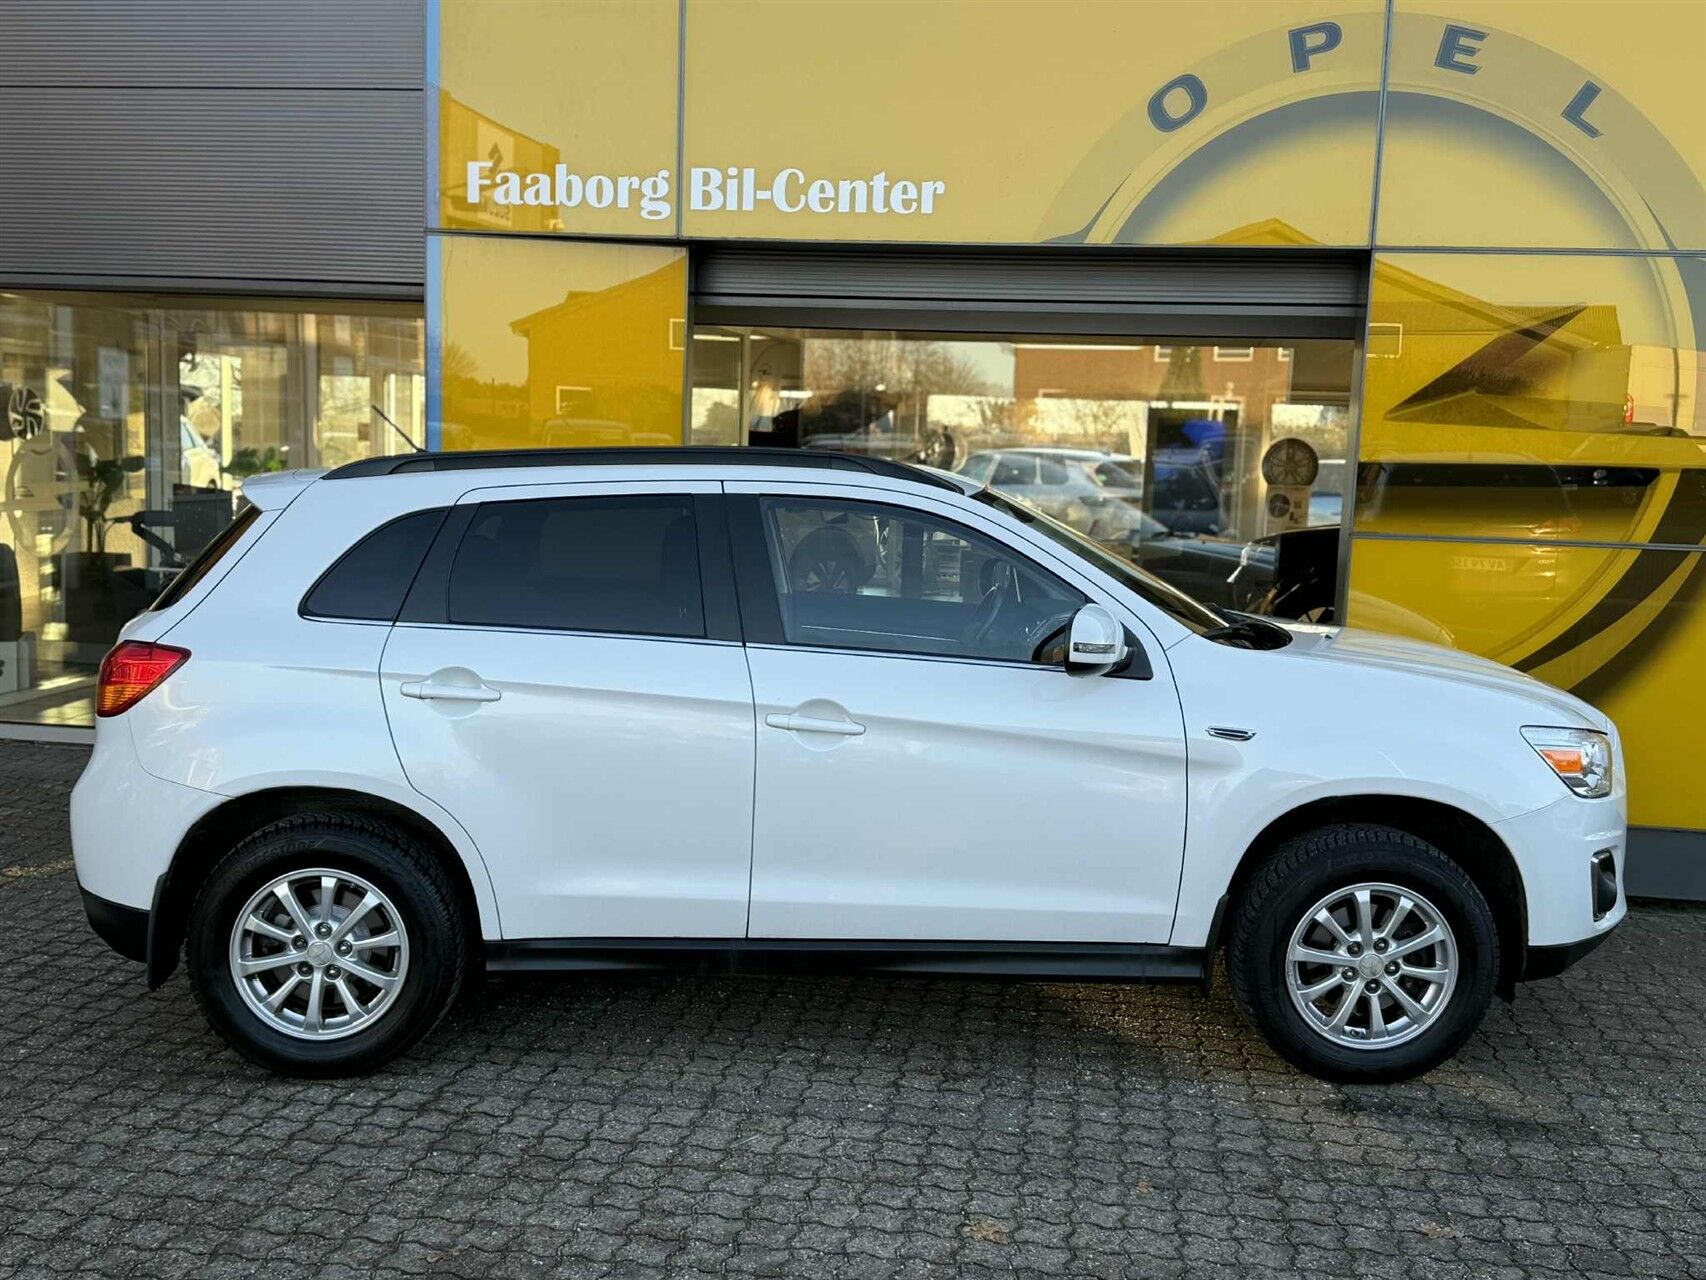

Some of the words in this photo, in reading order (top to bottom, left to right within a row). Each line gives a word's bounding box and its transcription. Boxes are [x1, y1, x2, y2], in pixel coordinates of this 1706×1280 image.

[1147, 21, 1604, 139] OPEL
[466, 161, 672, 220] Faaborg
[690, 166, 945, 215] Bil-Center
